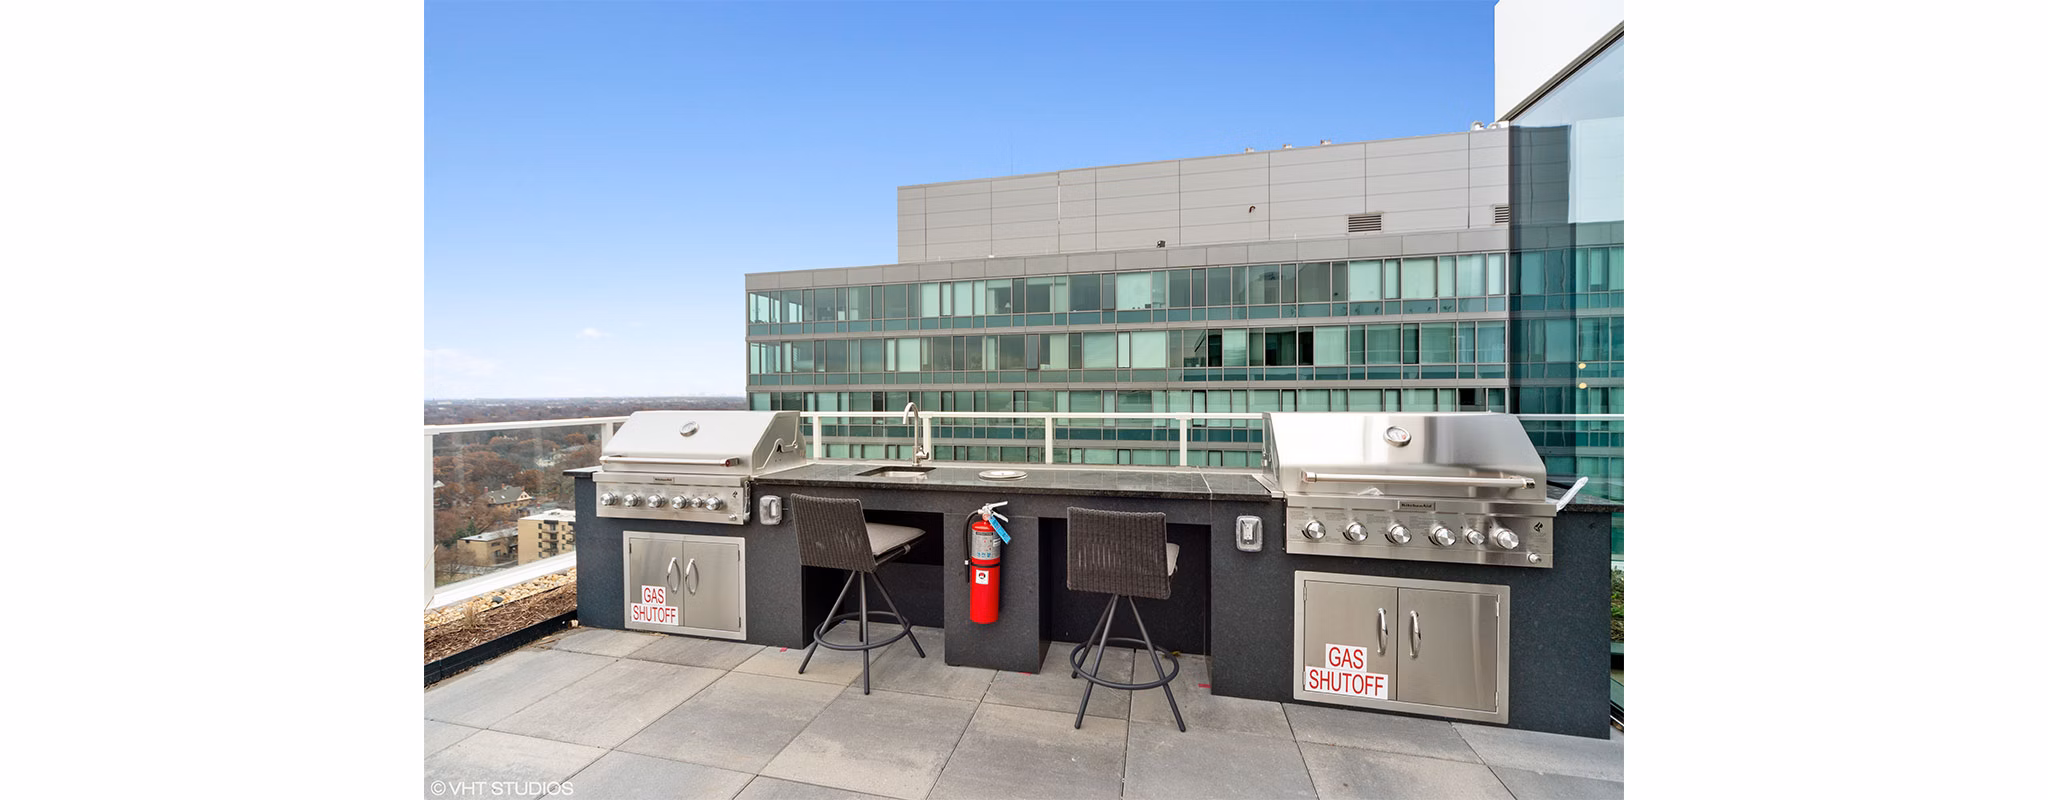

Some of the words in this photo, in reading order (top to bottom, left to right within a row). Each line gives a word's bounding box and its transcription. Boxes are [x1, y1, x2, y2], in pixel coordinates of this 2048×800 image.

[644, 587, 665, 604] GAS
[633, 605, 676, 623] SHUTOFF
[1328, 646, 1364, 669] GAS
[1309, 669, 1385, 696] SHUTOFF
